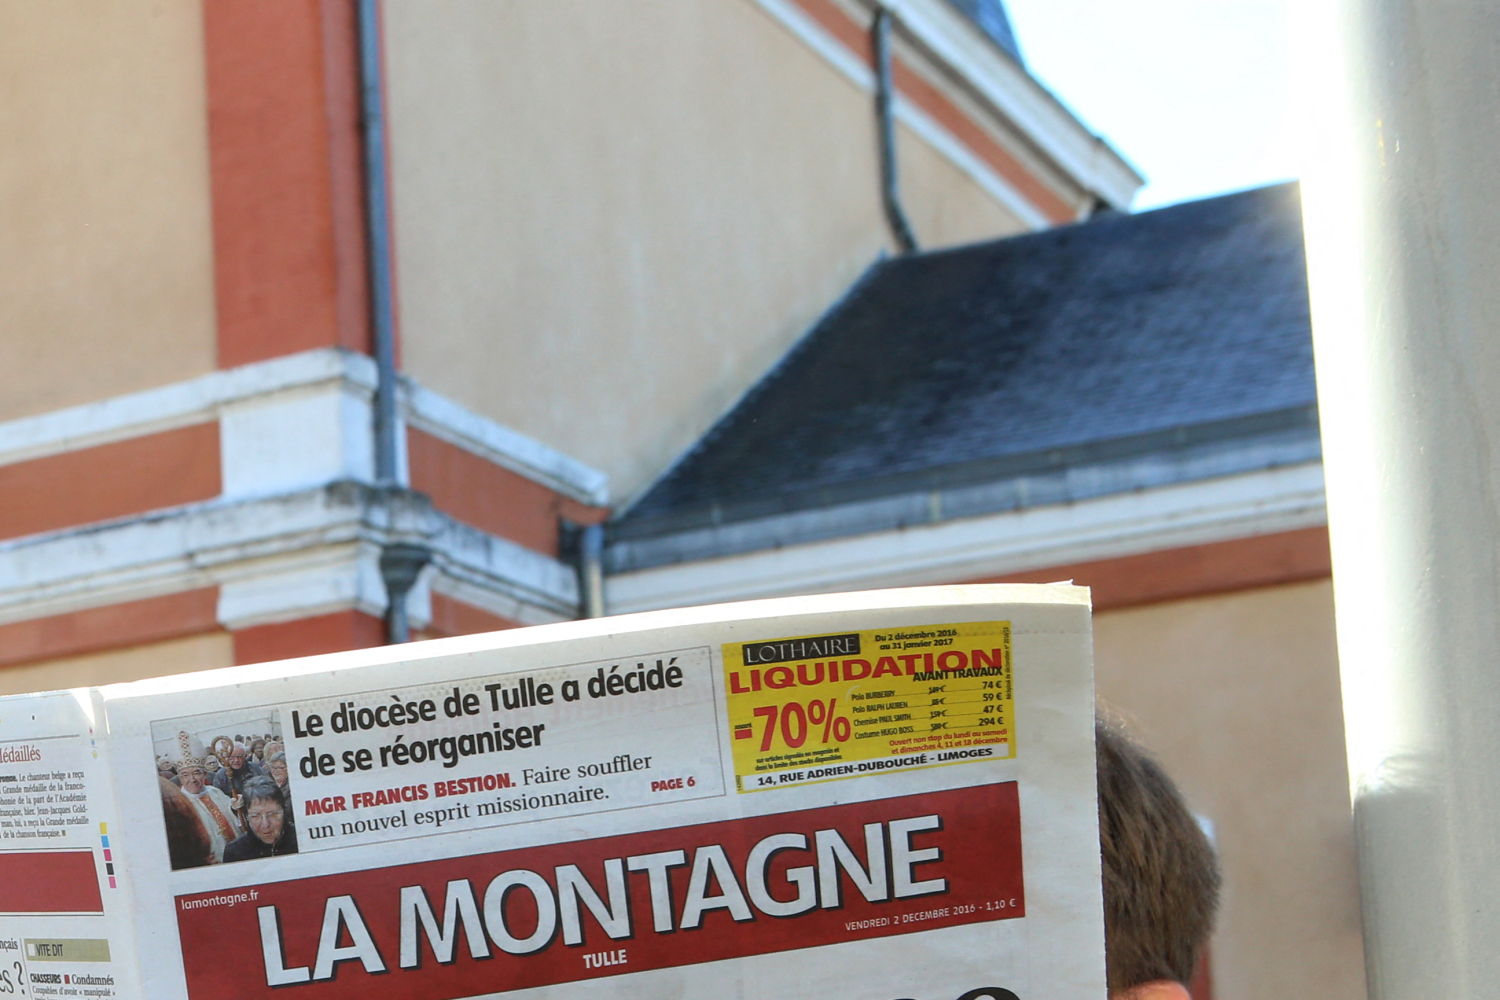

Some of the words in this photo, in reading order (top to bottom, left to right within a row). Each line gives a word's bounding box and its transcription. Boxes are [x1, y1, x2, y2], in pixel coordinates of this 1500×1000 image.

[894, 630, 936, 641] décembre
[936, 629, 958, 638] 2016
[903, 640, 932, 651] janvier
[933, 638, 954, 647] 2017
[746, 637, 858, 663] LOTHAIRE
[729, 648, 1002, 694] LIQUIDATION
[913, 670, 949, 682] AVANT
[953, 666, 1003, 679] TRAVAUX
[982, 681, 994, 690] 74
[292, 710, 324, 739] Le
[330, 695, 437, 734] diocèse
[443, 687, 480, 718] de
[484, 677, 554, 712] Tulle
[561, 680, 580, 702] a
[587, 657, 683, 699] décidé
[982, 693, 994, 702] 59
[982, 705, 995, 714] 47
[734, 698, 851, 752] -70%
[978, 717, 996, 727] 294
[299, 747, 336, 779] de
[342, 748, 373, 773] se
[379, 722, 545, 769] réorganiser
[899, 744, 936, 754] dimanches
[758, 776, 777, 786] 14,
[779, 771, 805, 783] RUE
[807, 753, 927, 779] ADRIEN-DUBOUCHÉ
[937, 748, 993, 762] LIMOGES
[305, 796, 347, 816] MGR
[351, 783, 429, 809] FRANCIS
[434, 772, 516, 798] BESTION.
[522, 766, 571, 786] Faire
[577, 754, 652, 778] souffler
[651, 777, 684, 792] PAGE
[686, 776, 696, 787] 6
[308, 825, 335, 840] un
[341, 809, 408, 835] nouvel
[414, 802, 471, 827] esprit
[476, 785, 609, 816] missionnaire.
[181, 889, 259, 910] lamontagne.fr
[256, 894, 387, 988] LA
[399, 814, 947, 970] MONTAGNE
[845, 917, 890, 931] VENDREDI
[902, 907, 950, 923] DECEMBRE
[953, 904, 976, 915] 2016
[986, 899, 1006, 911] 1,10
[35, 943, 51, 956] VITE
[52, 943, 63, 956] DIT
[582, 949, 628, 969] TULLE
[30, 973, 62, 984] CHASSEURS
[71, 973, 115, 986] Condamnés
